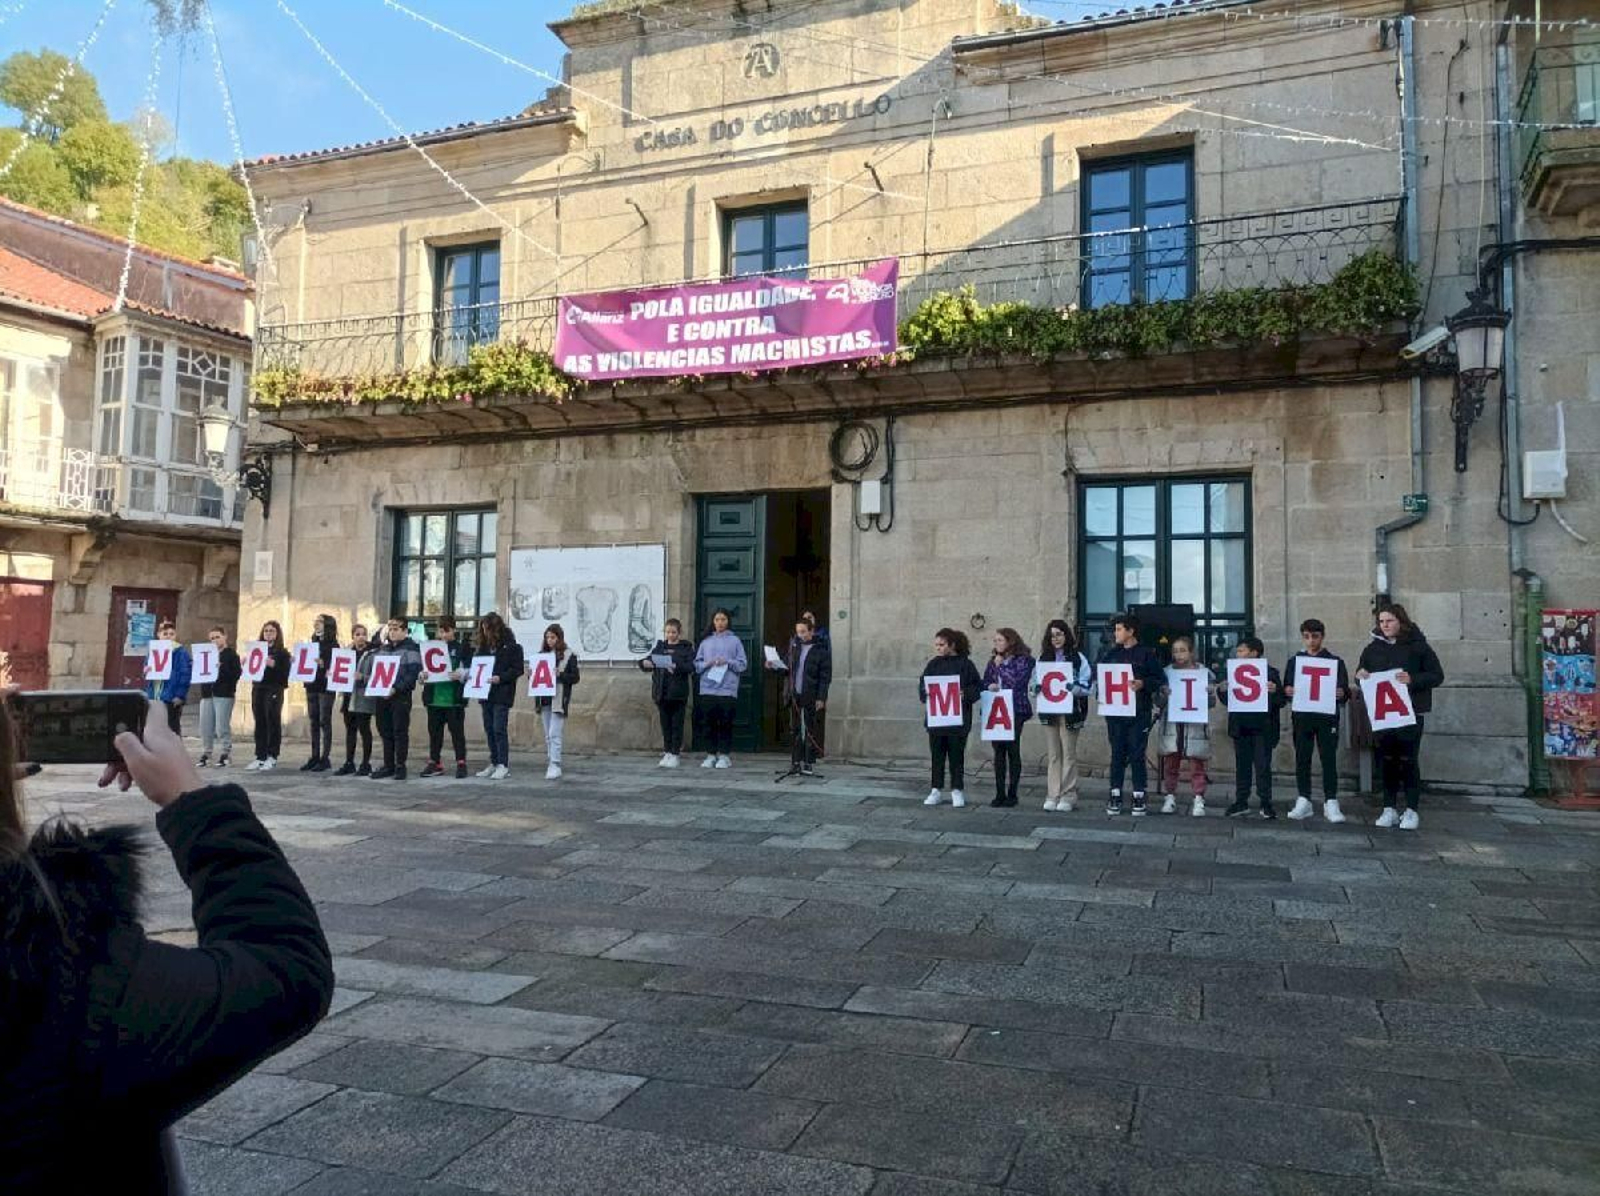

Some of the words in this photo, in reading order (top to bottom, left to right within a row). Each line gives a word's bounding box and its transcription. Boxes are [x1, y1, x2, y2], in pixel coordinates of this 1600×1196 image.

[635, 126, 698, 152] CASA
[709, 117, 744, 142] DO
[754, 95, 891, 136] CONCELLO
[630, 296, 685, 321] POLA
[667, 324, 679, 343] E
[684, 315, 776, 341] CONTRA
[563, 354, 593, 374] AS
[597, 347, 725, 371] VIOLENCIAS
